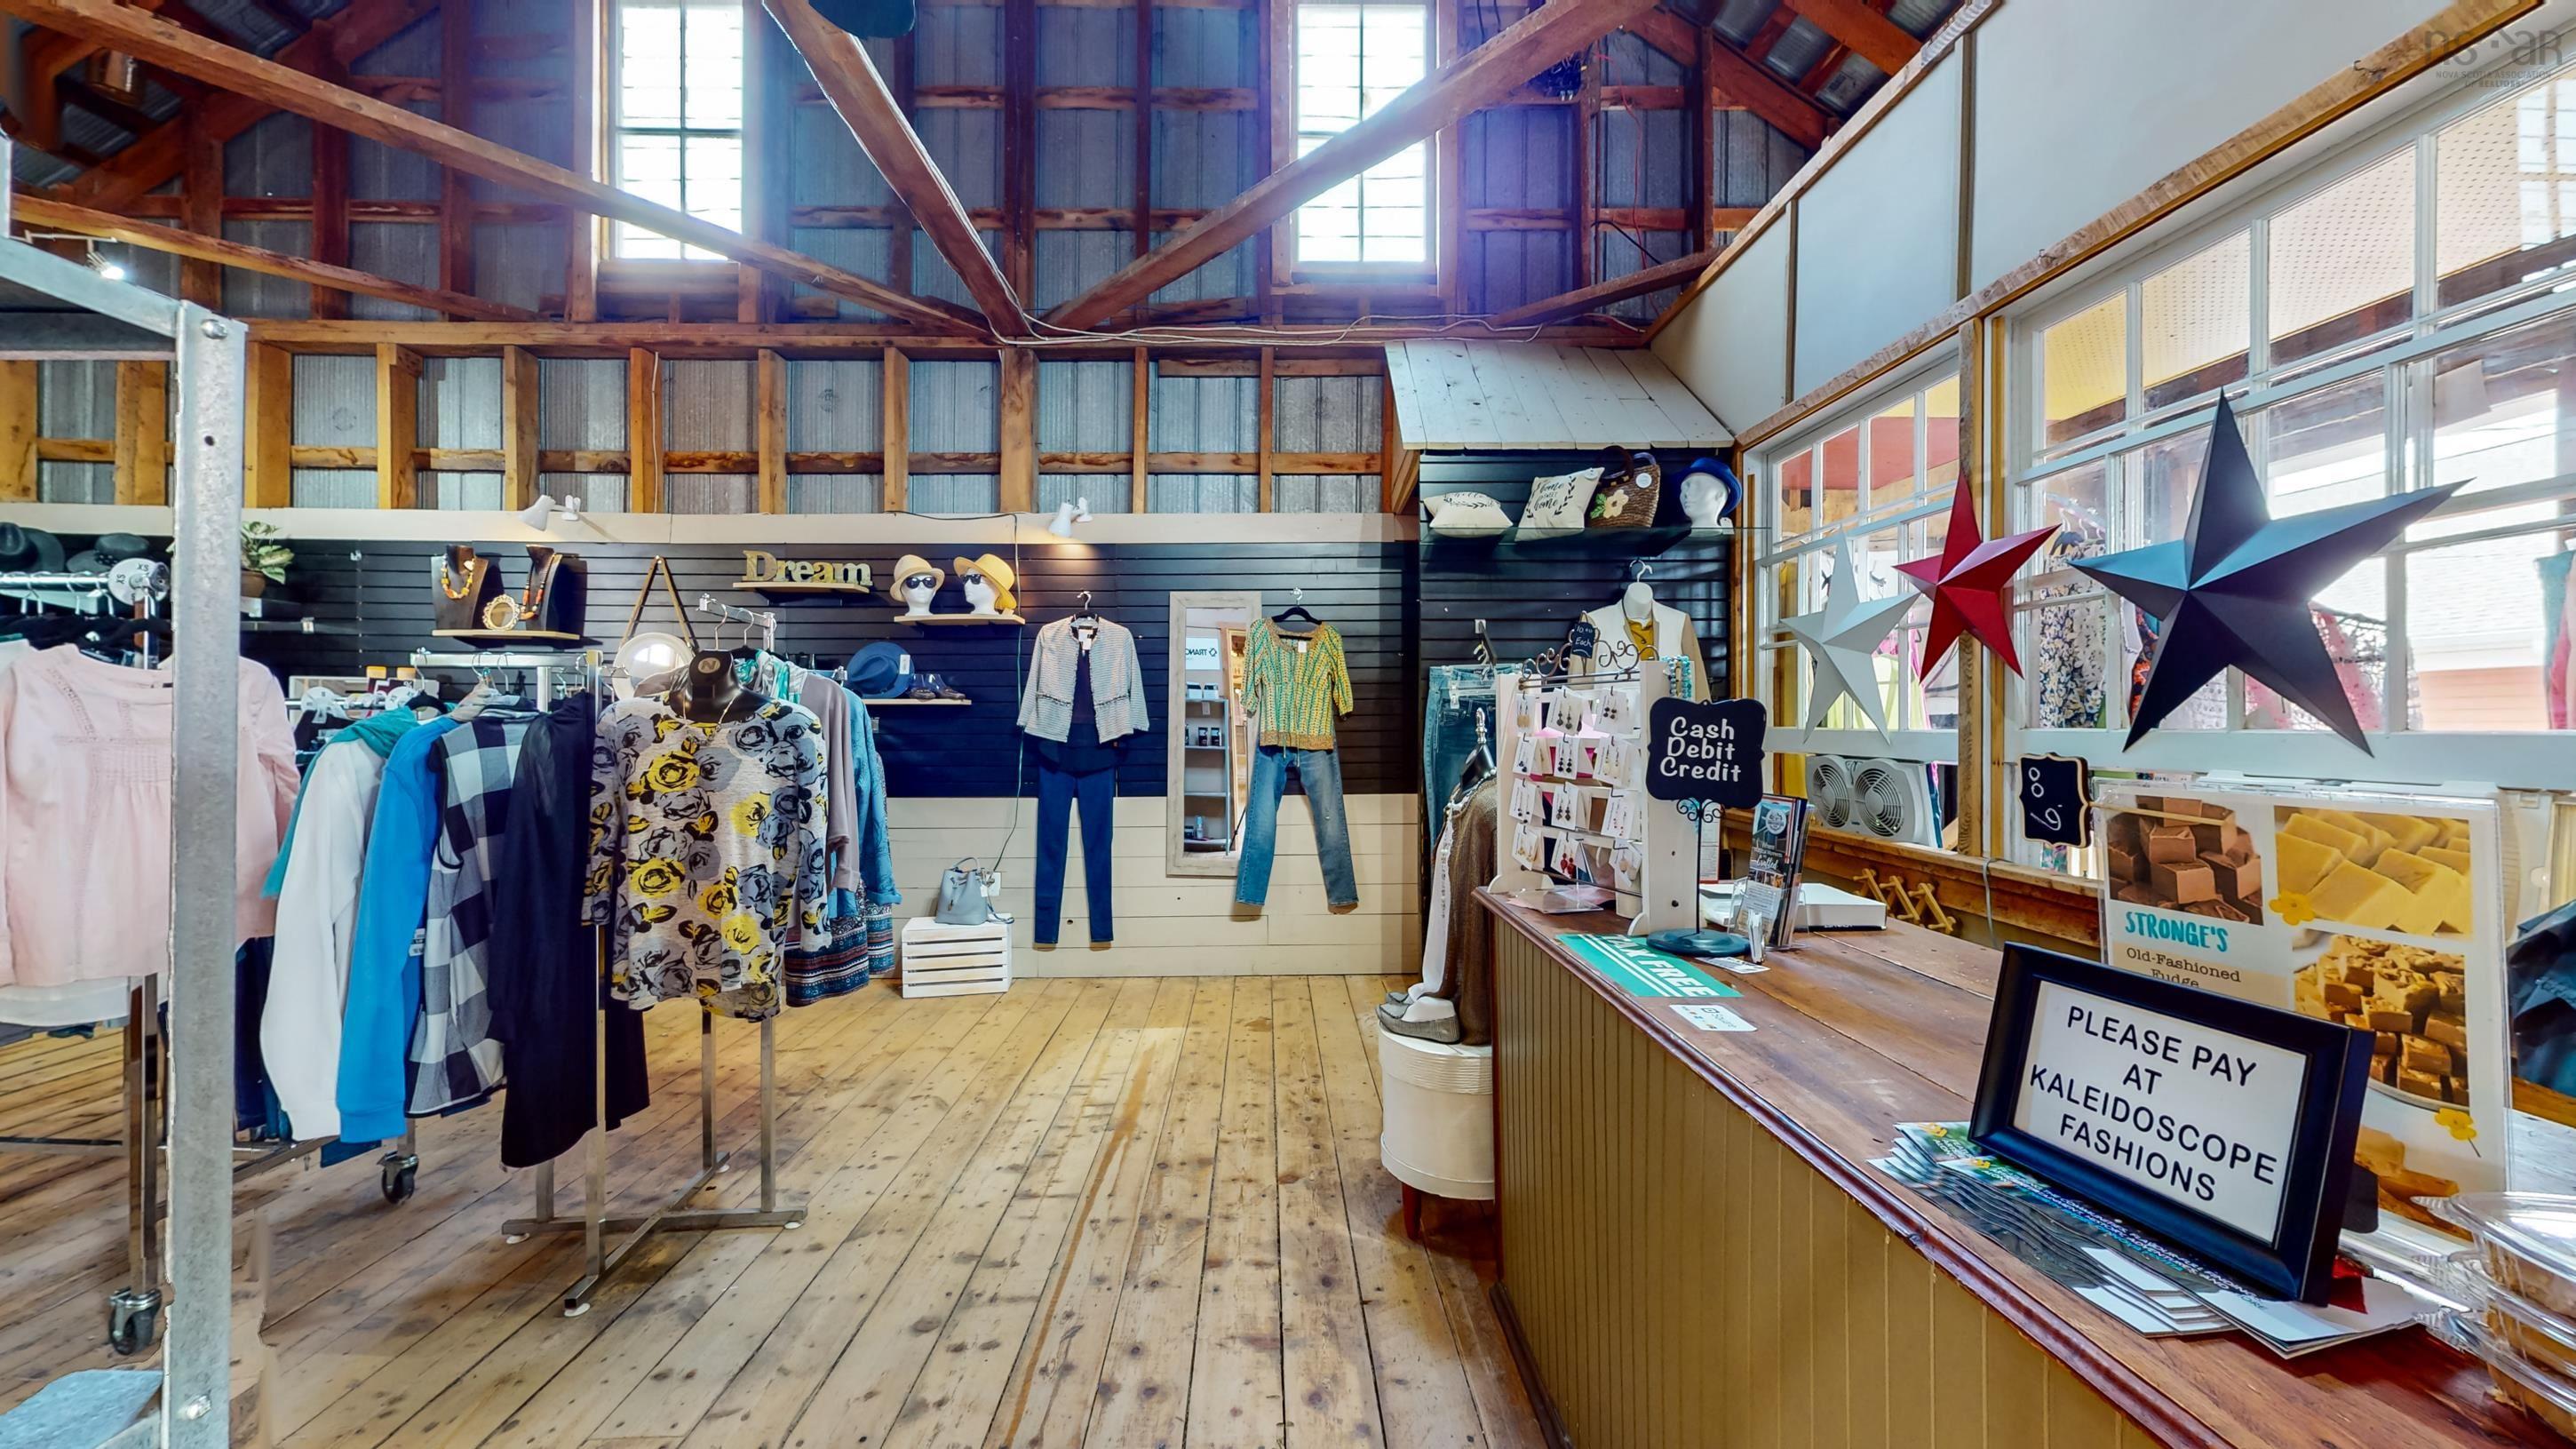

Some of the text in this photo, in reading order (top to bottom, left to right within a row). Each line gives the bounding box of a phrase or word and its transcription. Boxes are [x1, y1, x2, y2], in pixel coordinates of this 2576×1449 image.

[742, 550, 873, 586] Dream
[1670, 716, 1735, 740] Cash
[1667, 736, 1736, 760] Debit
[1659, 756, 1742, 782] Credit
[2125, 912, 2229, 952] STRONGE'S
[1637, 959, 1721, 997] FREE
[2127, 947, 2242, 983] Old-Fashioned
[2067, 1006, 2257, 1087] PLEASE PAY
[2123, 1063, 2162, 1095] AT
[2030, 1063, 2278, 1185] KALEIDOSCOPE
[2060, 1113, 2215, 1201] FASHIONS
